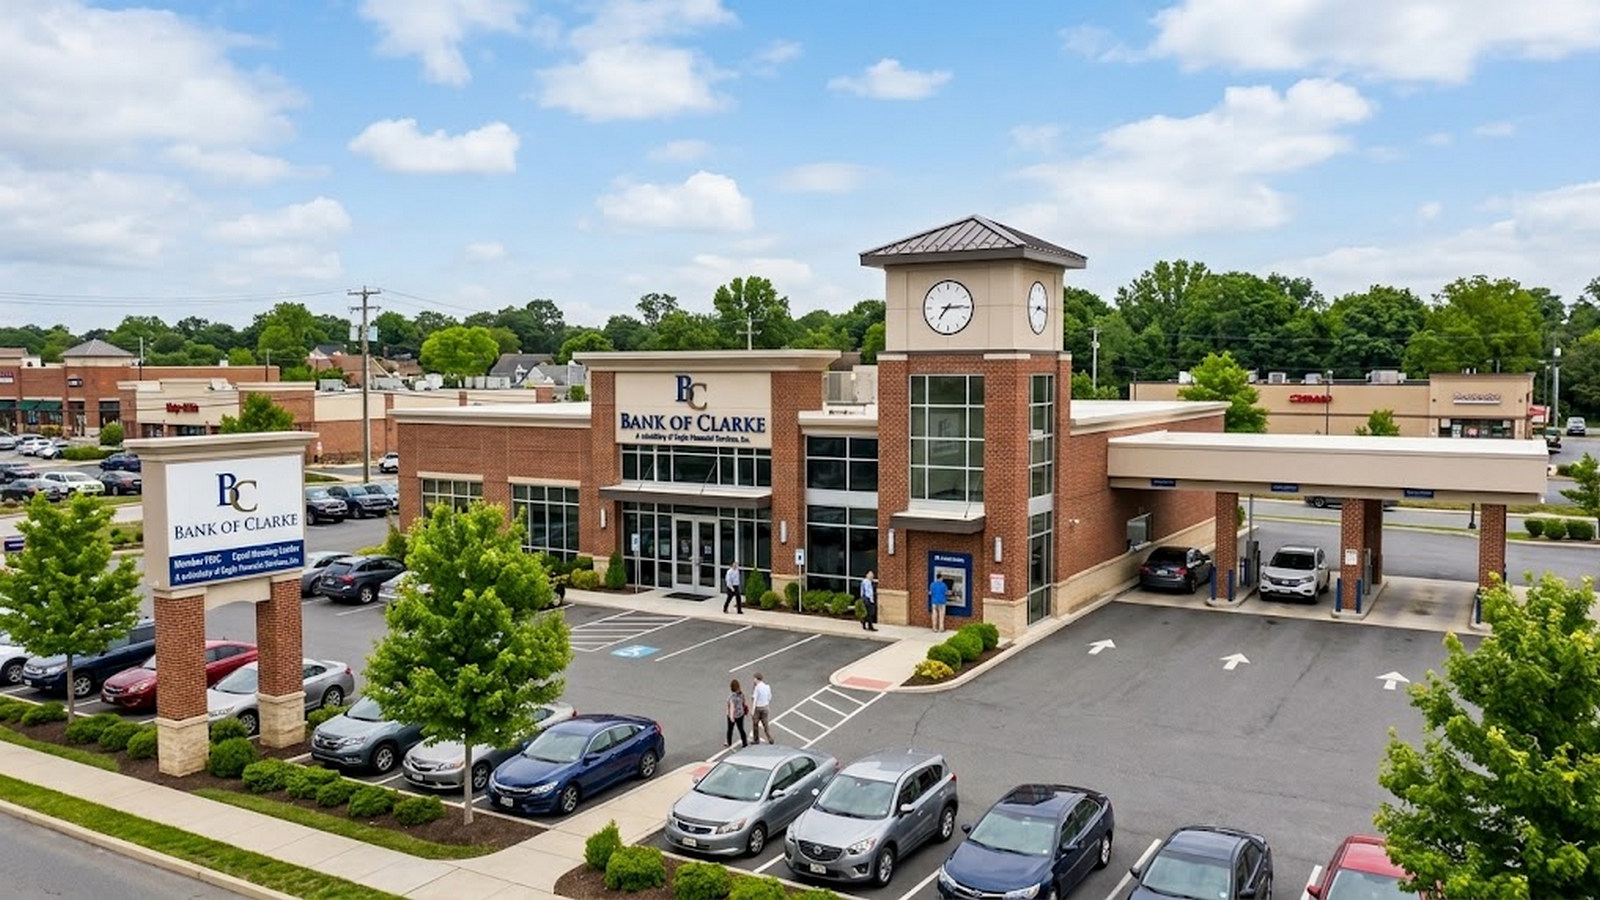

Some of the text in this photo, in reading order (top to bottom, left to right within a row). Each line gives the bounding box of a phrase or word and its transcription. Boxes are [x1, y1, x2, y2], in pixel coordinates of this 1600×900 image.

[620, 412, 766, 433] BANK OF CLARKE
[215, 472, 258, 512] BC
[174, 514, 298, 540] BANK OF CLARKE
